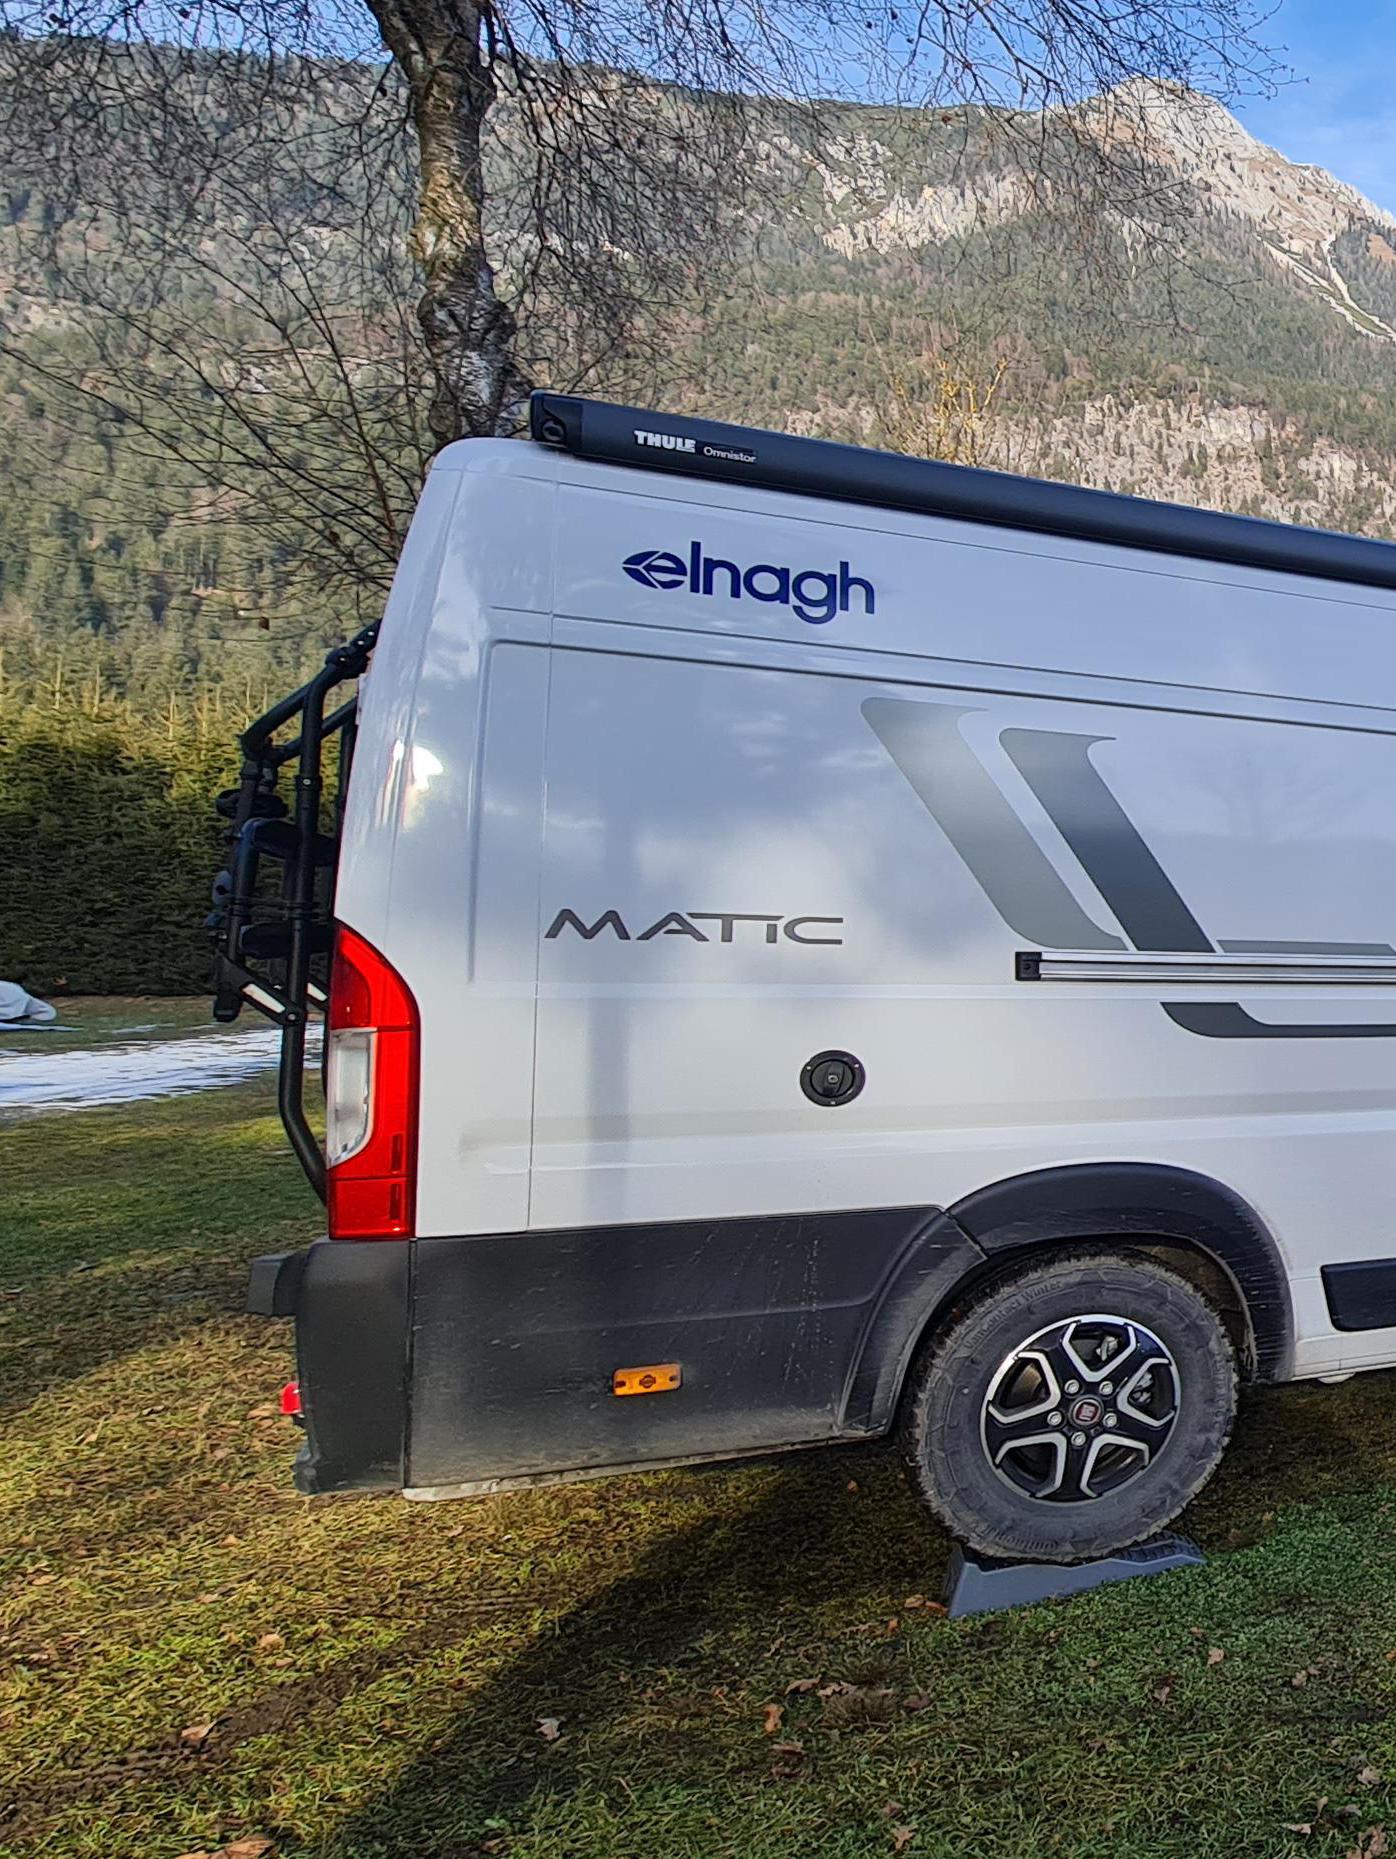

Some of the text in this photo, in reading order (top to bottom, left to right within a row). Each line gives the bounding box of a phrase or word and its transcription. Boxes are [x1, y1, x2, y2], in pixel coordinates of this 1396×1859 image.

[633, 429, 758, 463] THULE Omnistor
[622, 540, 876, 625] elnagh
[544, 908, 844, 945] MATIC
